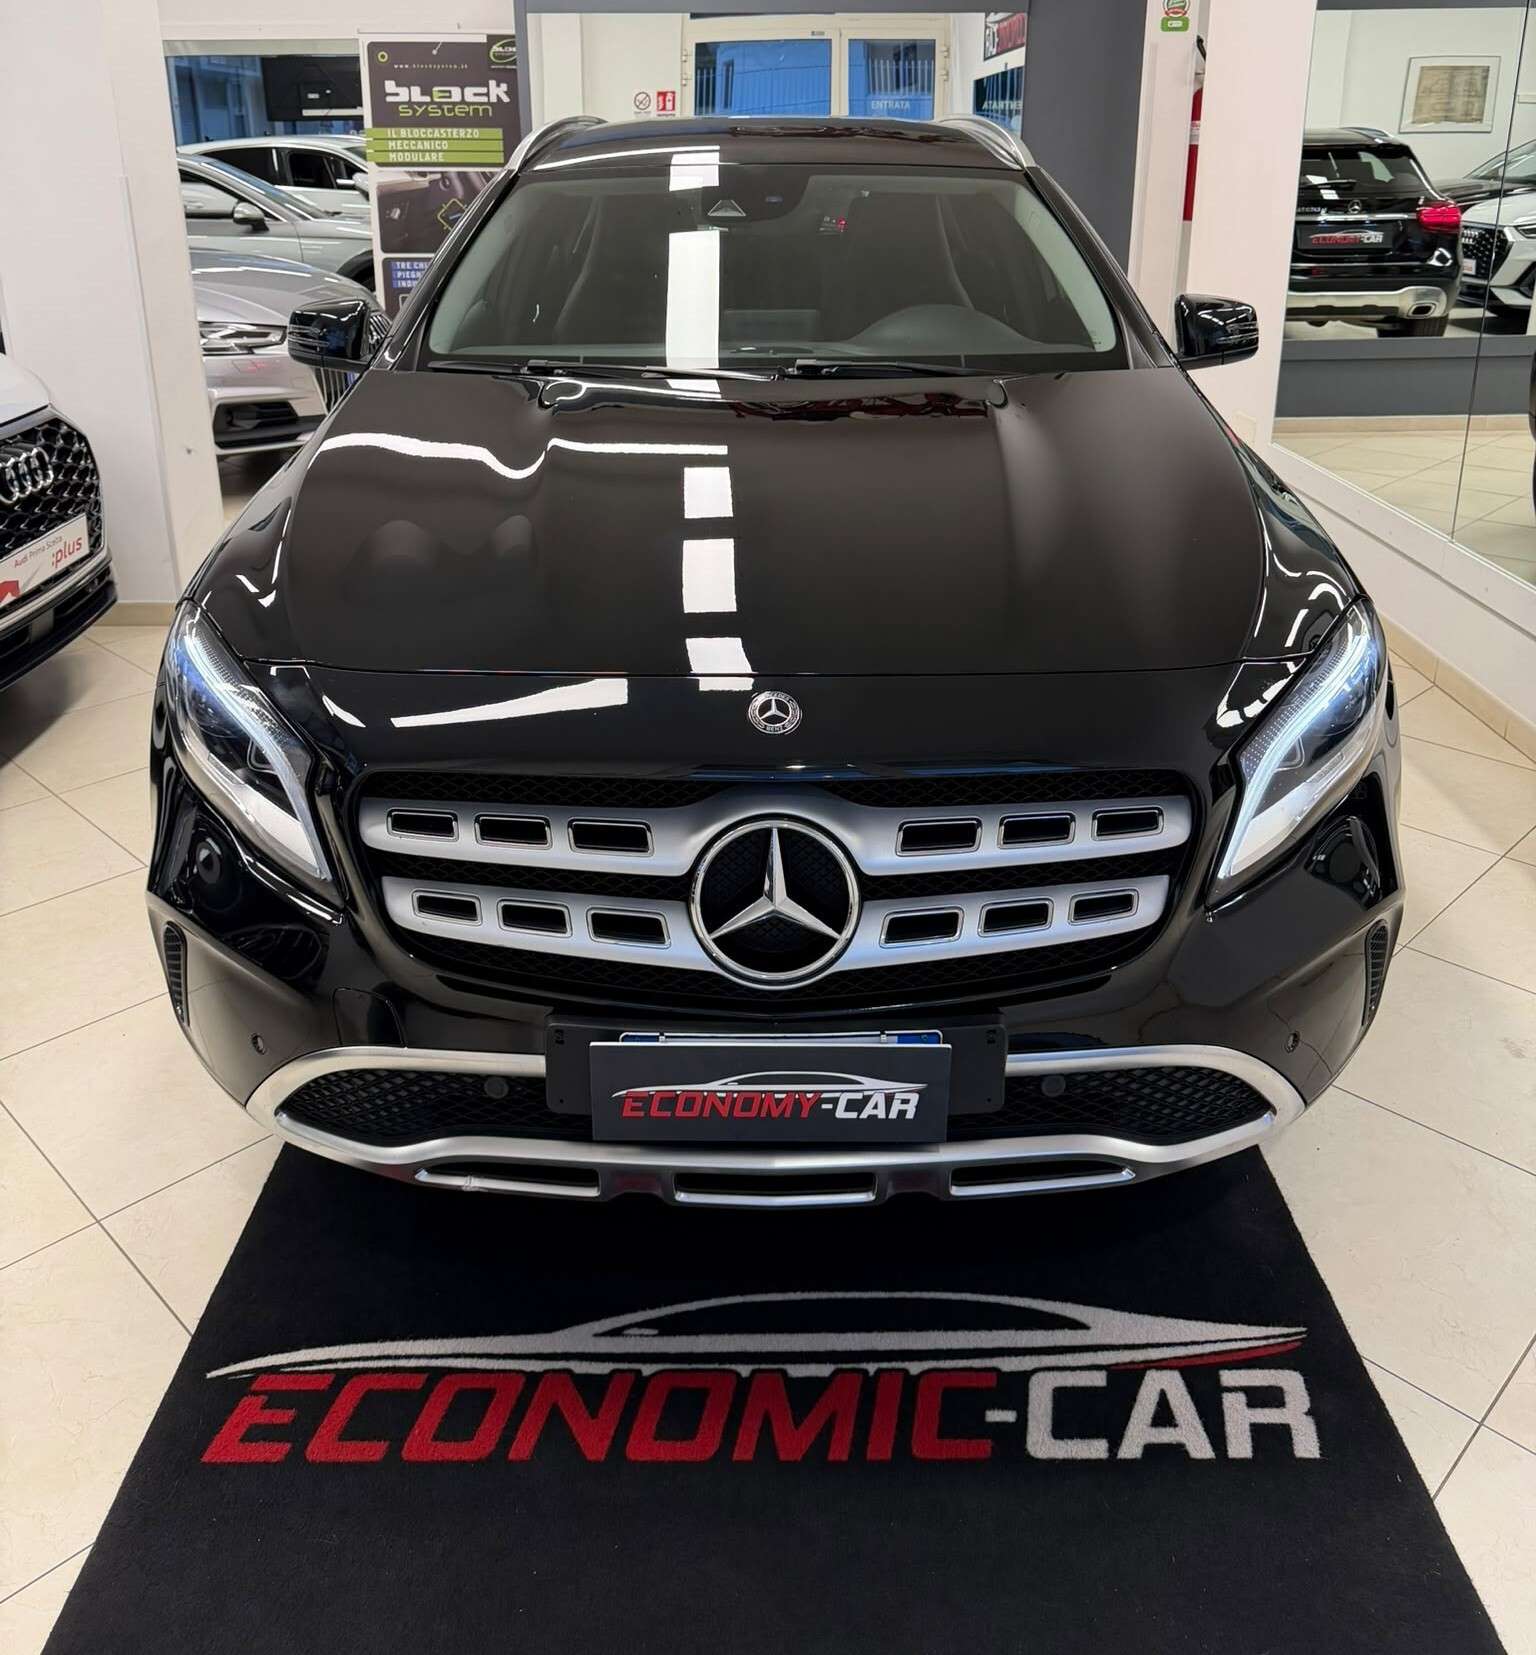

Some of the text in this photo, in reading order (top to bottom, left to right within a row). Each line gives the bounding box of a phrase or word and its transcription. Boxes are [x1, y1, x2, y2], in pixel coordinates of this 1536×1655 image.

[386, 128, 480, 138] IL BLOCCASTERZO
[388, 140, 449, 150] MECCANICO
[389, 151, 445, 162] MODULARE
[621, 1090, 919, 1120] ECONOMY-CAR
[201, 1369, 1322, 1462] ECONOMIC-CAR
